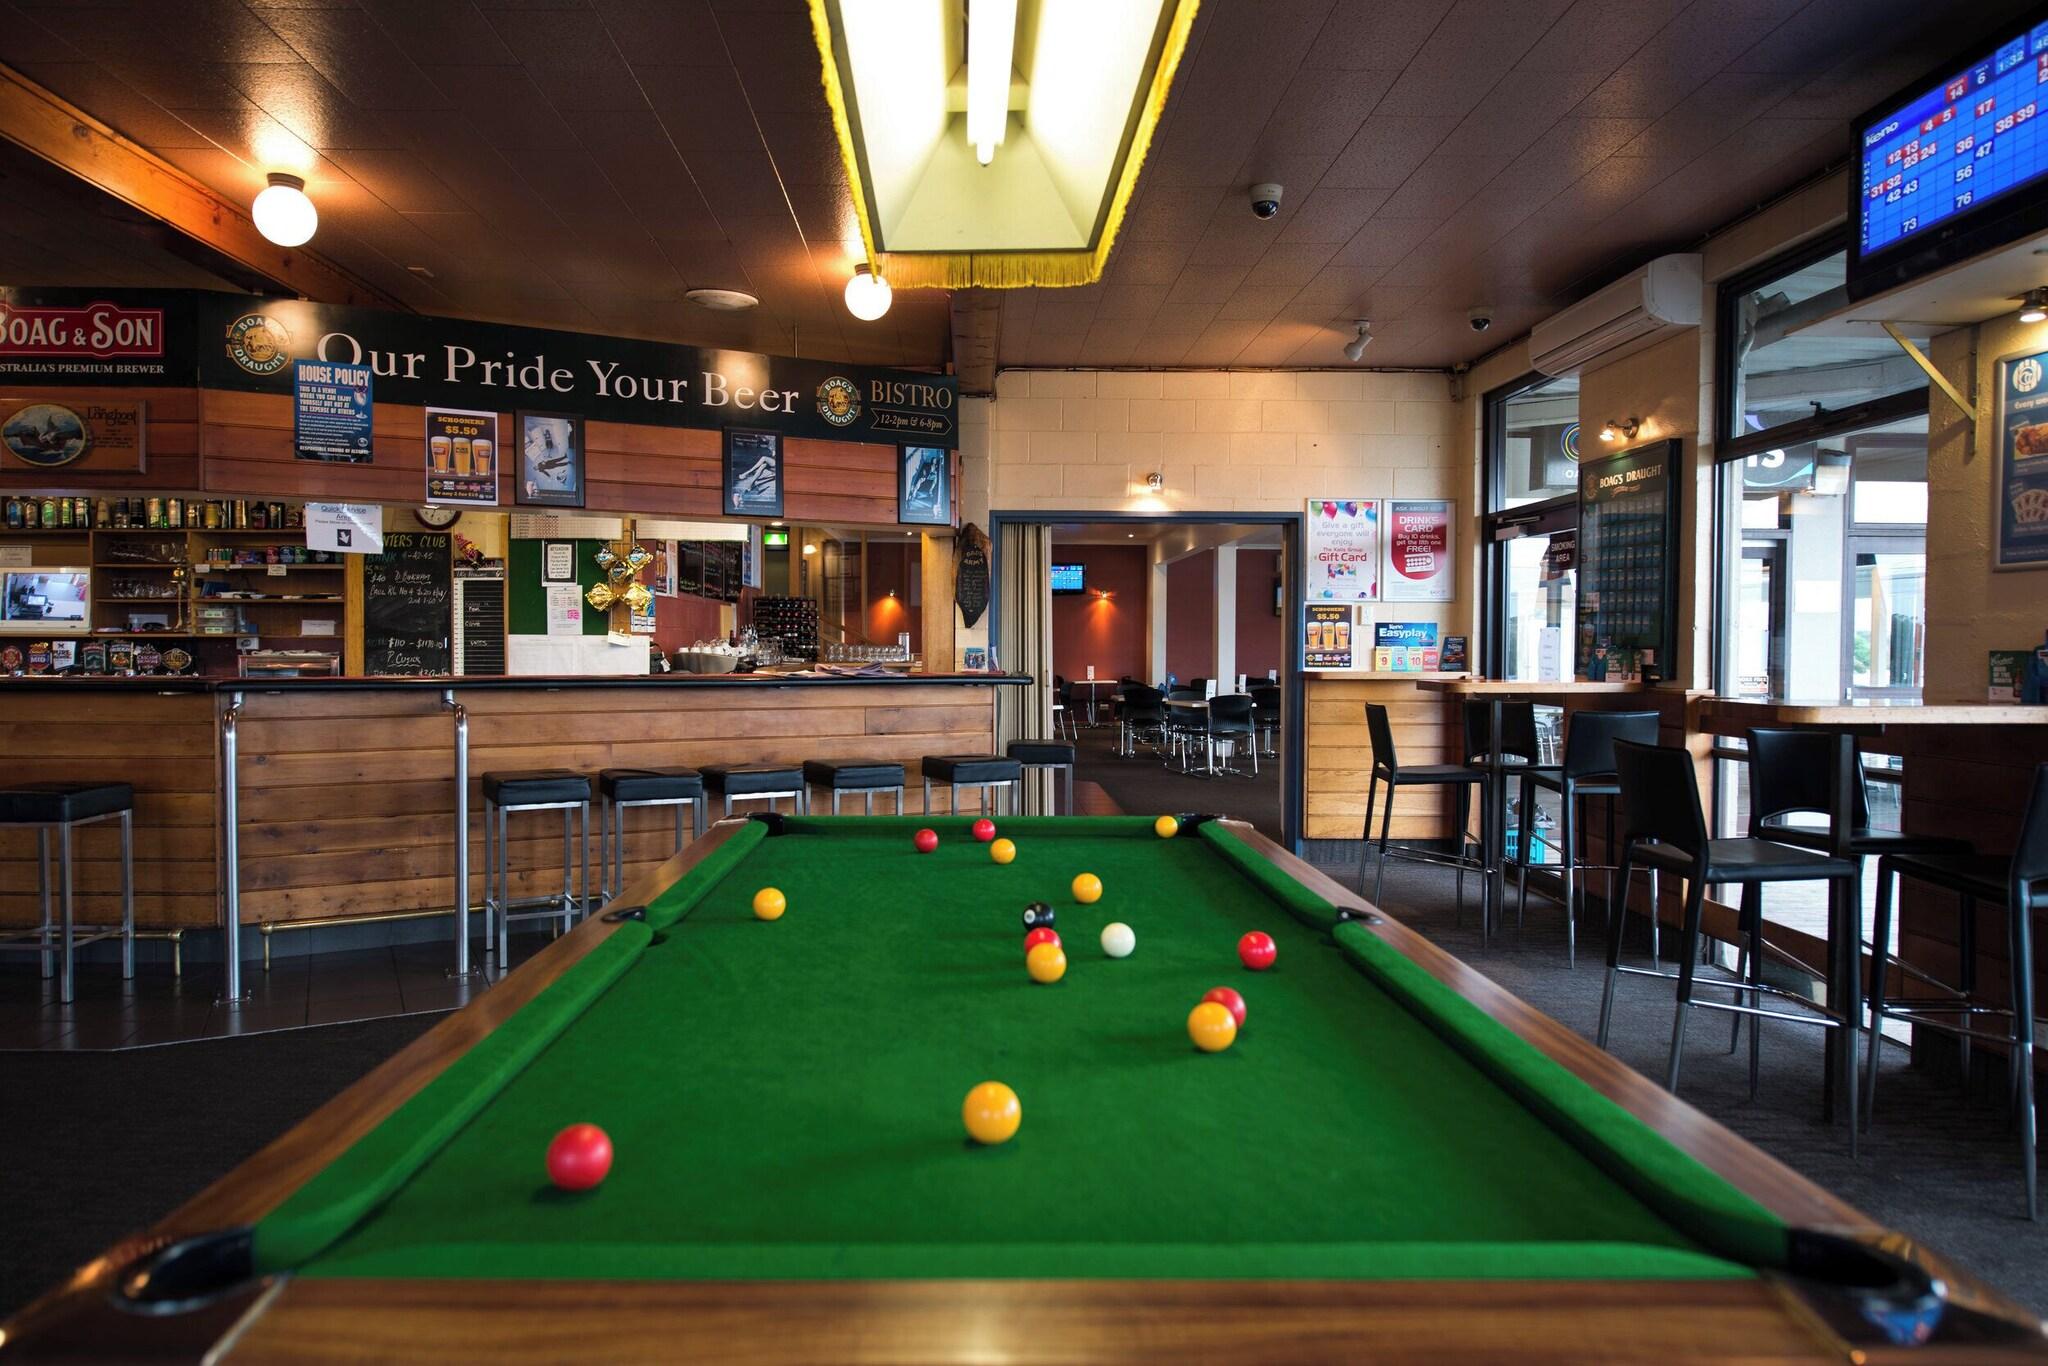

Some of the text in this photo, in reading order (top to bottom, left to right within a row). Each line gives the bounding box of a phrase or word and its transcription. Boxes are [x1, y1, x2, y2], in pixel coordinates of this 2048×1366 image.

[1978, 71, 1986, 84] 6
[1950, 85, 1964, 100] 14
[1924, 119, 1933, 132] 4
[1943, 109, 1952, 122] 5
[1888, 149, 1901, 165] 12
[1906, 140, 1919, 155] 13
[1977, 98, 1993, 115] 17
[1871, 104, 2036, 199] 31 32 36 38 39
[1903, 143, 1936, 170] 23 24
[1886, 140, 1993, 203] 42 43 47
[1955, 165, 1973, 182] 56
[1903, 192, 1972, 233] 73 76
[73, 328, 86, 346] &
[91, 311, 153, 349] SON
[234, 349, 285, 371] DRAUGHT
[58, 363, 113, 374] PREMIUM
[116, 364, 164, 375] BREWER
[298, 365, 369, 387] HOUSE POLICY
[317, 332, 800, 414] Our Pride Your Beer
[824, 379, 853, 393] BOAG'S
[871, 380, 952, 409] BISTRO
[437, 416, 485, 425] SCHOONERS
[822, 405, 856, 423] DRAUGHT
[445, 425, 478, 435] $5.50
[881, 414, 943, 431] 12-2pm & 6-8pm
[1599, 464, 1662, 489] BOAG'S DRAUGHT
[1322, 521, 1339, 529] Give
[1350, 522, 1364, 530] gift
[1399, 516, 1440, 525] DRINKS
[1404, 524, 1433, 533] CARD
[420, 535, 446, 548] CLUB
[1551, 540, 1576, 552] SMOKING
[1318, 552, 1367, 562] Gift Card
[1555, 553, 1570, 562] AREA
[1379, 628, 1427, 639] Easyplay
[1381, 656, 1388, 665] 9
[1411, 656, 1421, 666] 10
